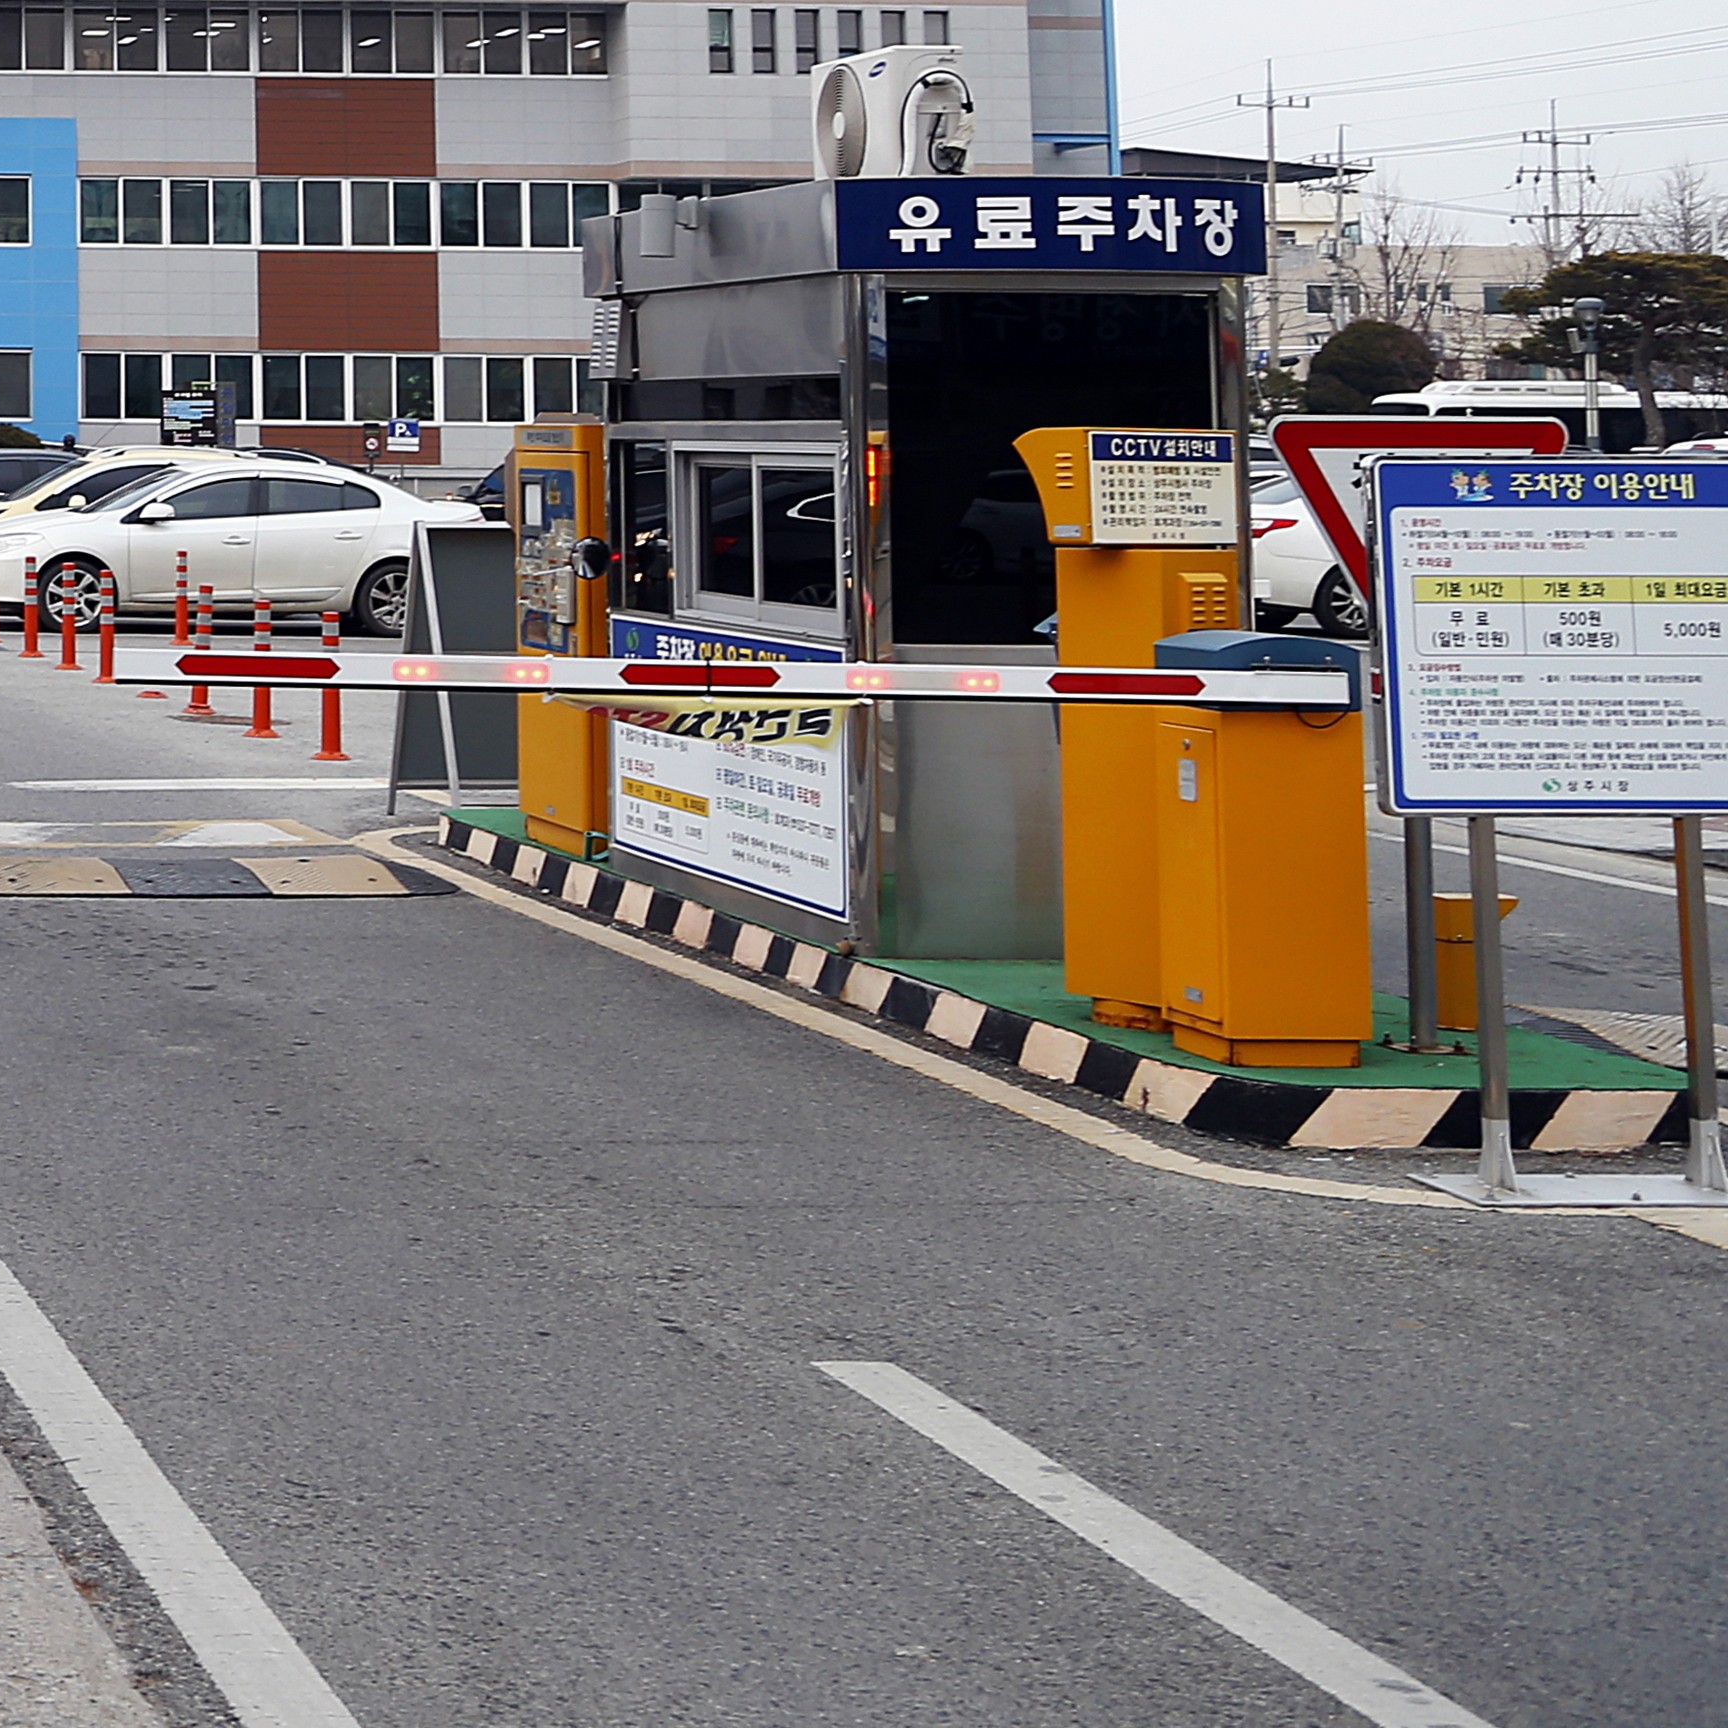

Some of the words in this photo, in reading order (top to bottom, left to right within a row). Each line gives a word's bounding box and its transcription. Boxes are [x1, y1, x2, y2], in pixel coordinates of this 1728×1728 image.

[888, 194, 1239, 257] 유료주차장
[395, 422, 407, 437] P
[1509, 472, 1586, 501] 주차장
[1593, 471, 1696, 501] 이용안내
[1435, 582, 1463, 598] 기본
[1469, 581, 1504, 598] 1시간
[1543, 581, 1571, 598] 기본
[1578, 581, 1606, 598] 초과
[1646, 582, 1666, 598] 1일
[1674, 581, 1727, 598] 최대요금
[1559, 610, 1602, 627] 500원
[1663, 621, 1722, 638] 5,000원
[1567, 780, 1629, 792] 상주시장
